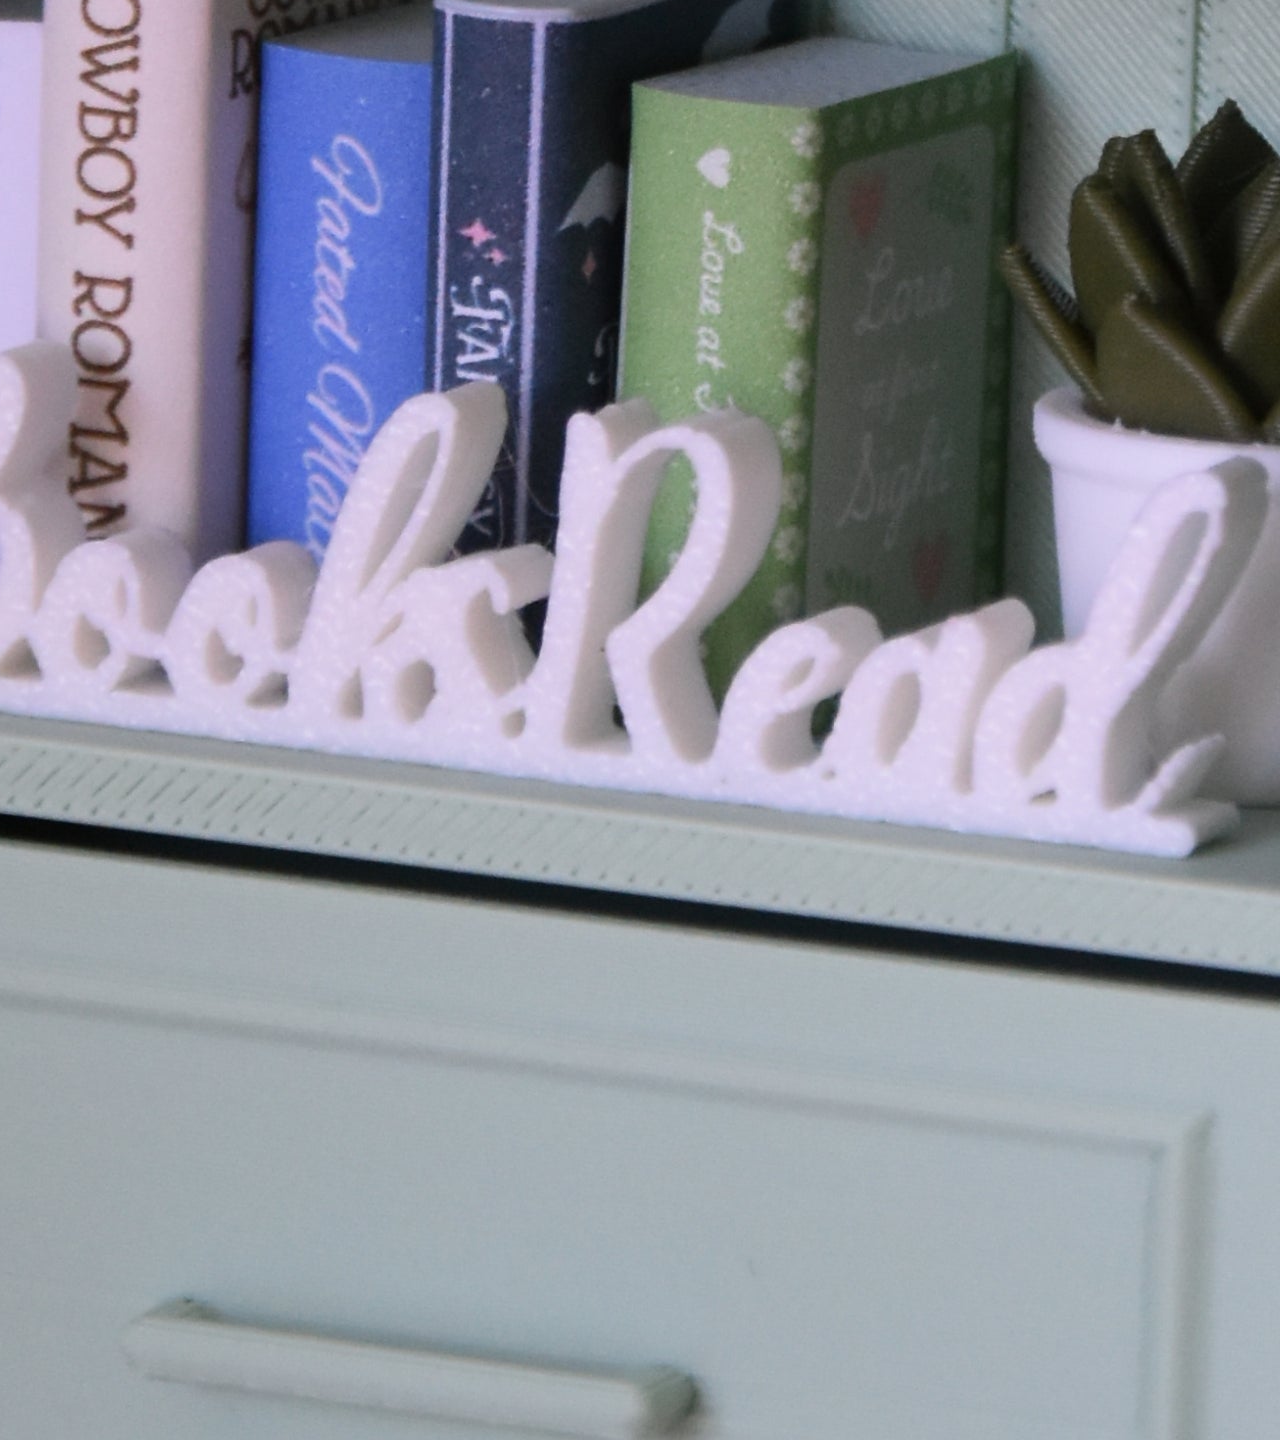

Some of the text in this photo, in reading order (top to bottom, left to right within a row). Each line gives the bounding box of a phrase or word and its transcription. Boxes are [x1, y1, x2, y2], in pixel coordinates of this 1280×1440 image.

[698, 209, 746, 316] Love
[695, 325, 729, 371] at
[67, 269, 134, 541] ROMAN
